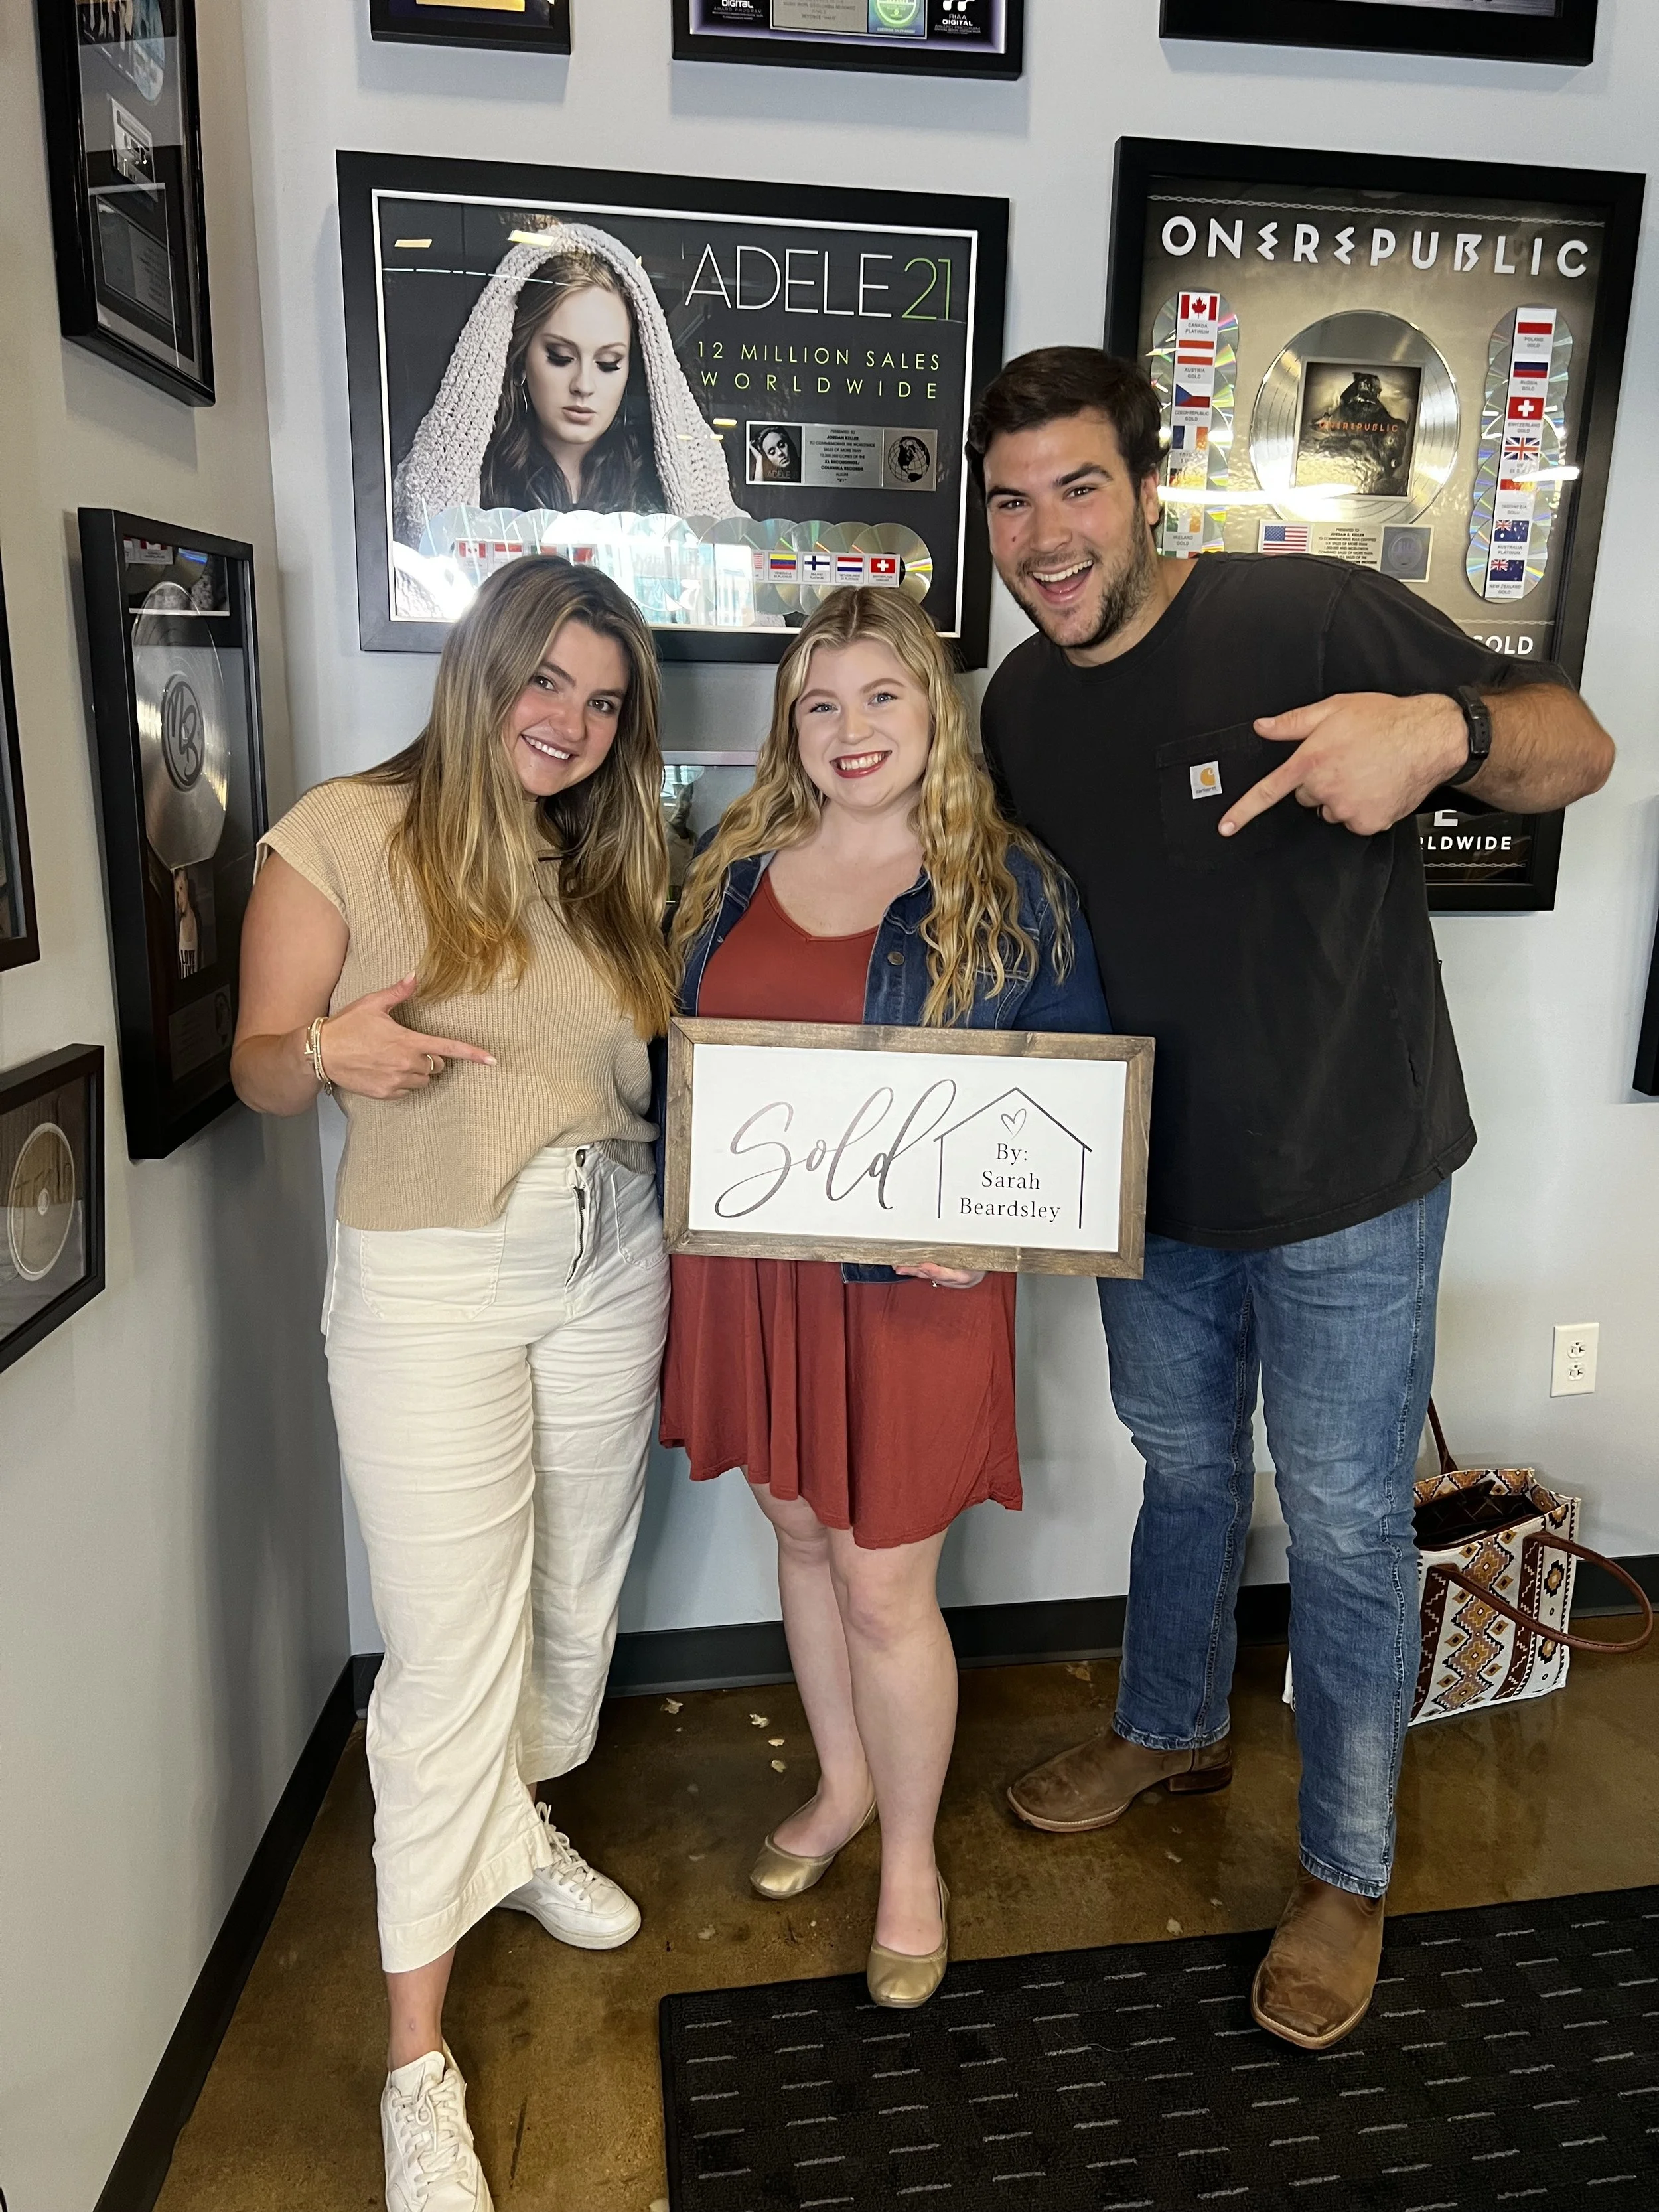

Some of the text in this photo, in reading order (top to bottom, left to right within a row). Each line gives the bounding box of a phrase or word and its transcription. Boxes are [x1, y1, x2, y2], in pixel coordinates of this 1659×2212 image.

[1161, 216, 1589, 278] ONEREPUBLIC
[685, 243, 951, 321] ADELE 21
[698, 341, 940, 370] 12 MILLION SALES
[701, 370, 936, 399] WORLDWIDE
[714, 1078, 957, 1218] Sold
[996, 1143, 1028, 1165] By:
[981, 1170, 1041, 1190] Sarah
[960, 1197, 1061, 1223] Beardsley
